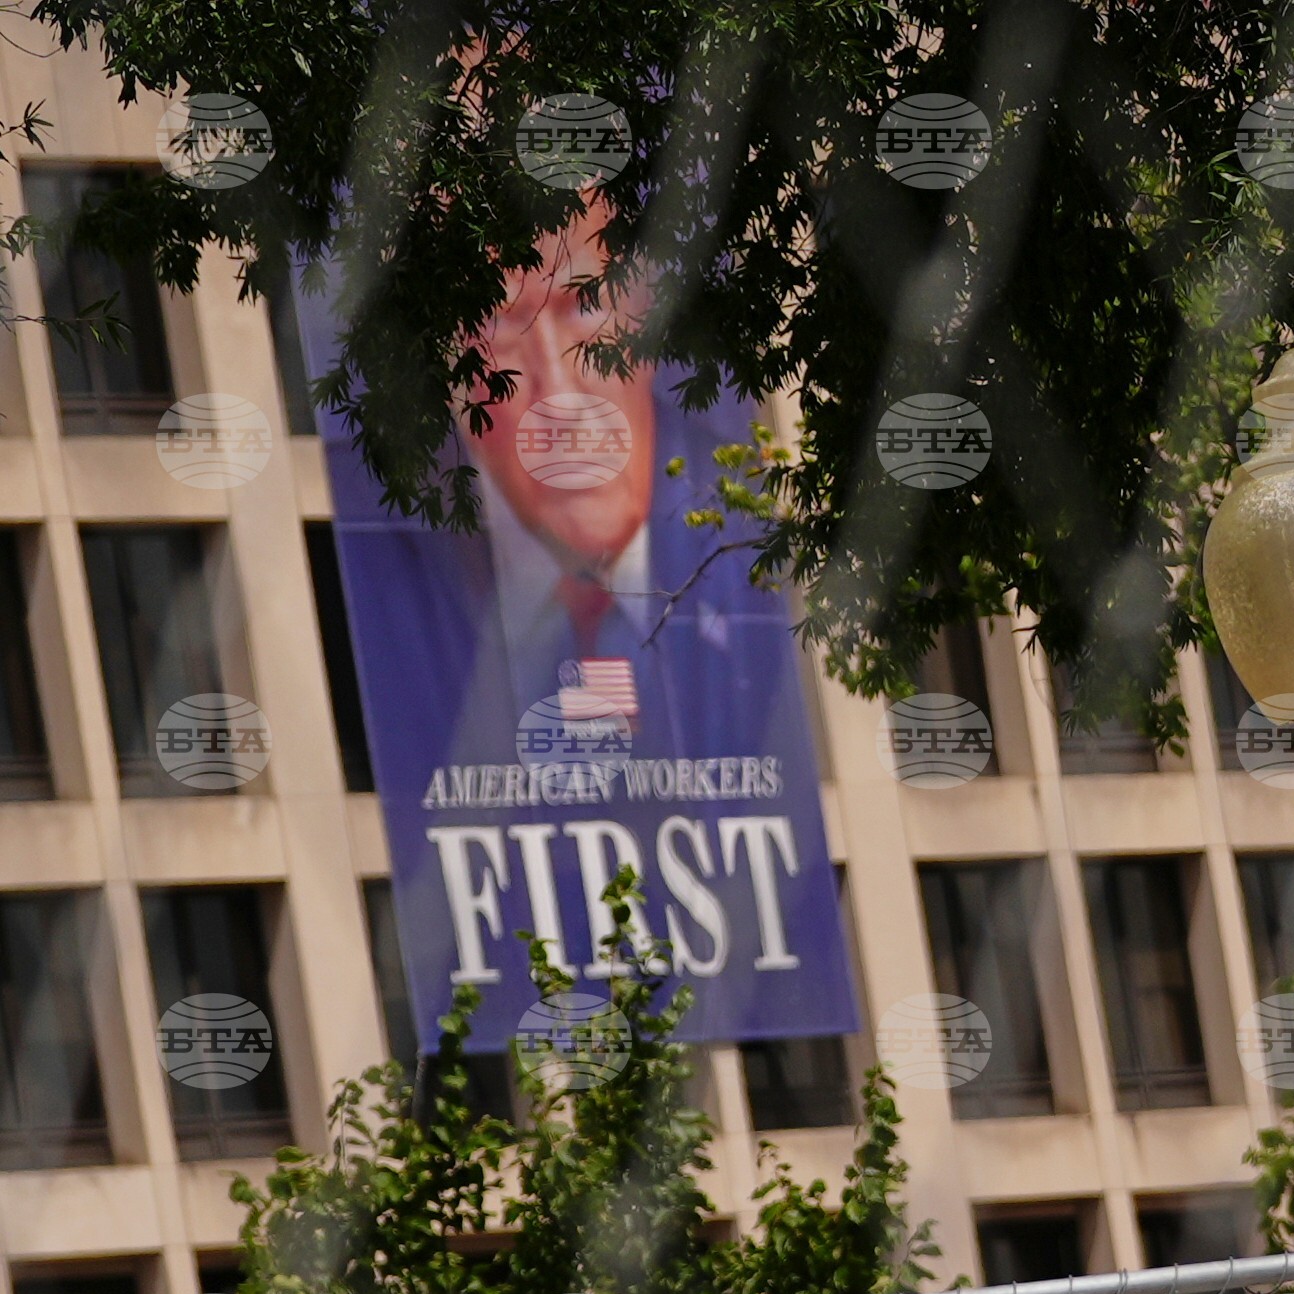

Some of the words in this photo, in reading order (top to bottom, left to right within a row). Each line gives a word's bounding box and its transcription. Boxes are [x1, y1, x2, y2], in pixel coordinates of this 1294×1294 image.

[421, 760, 613, 810] AMERICAN
[622, 756, 783, 803] WORKERS
[426, 814, 800, 984] FIRST
